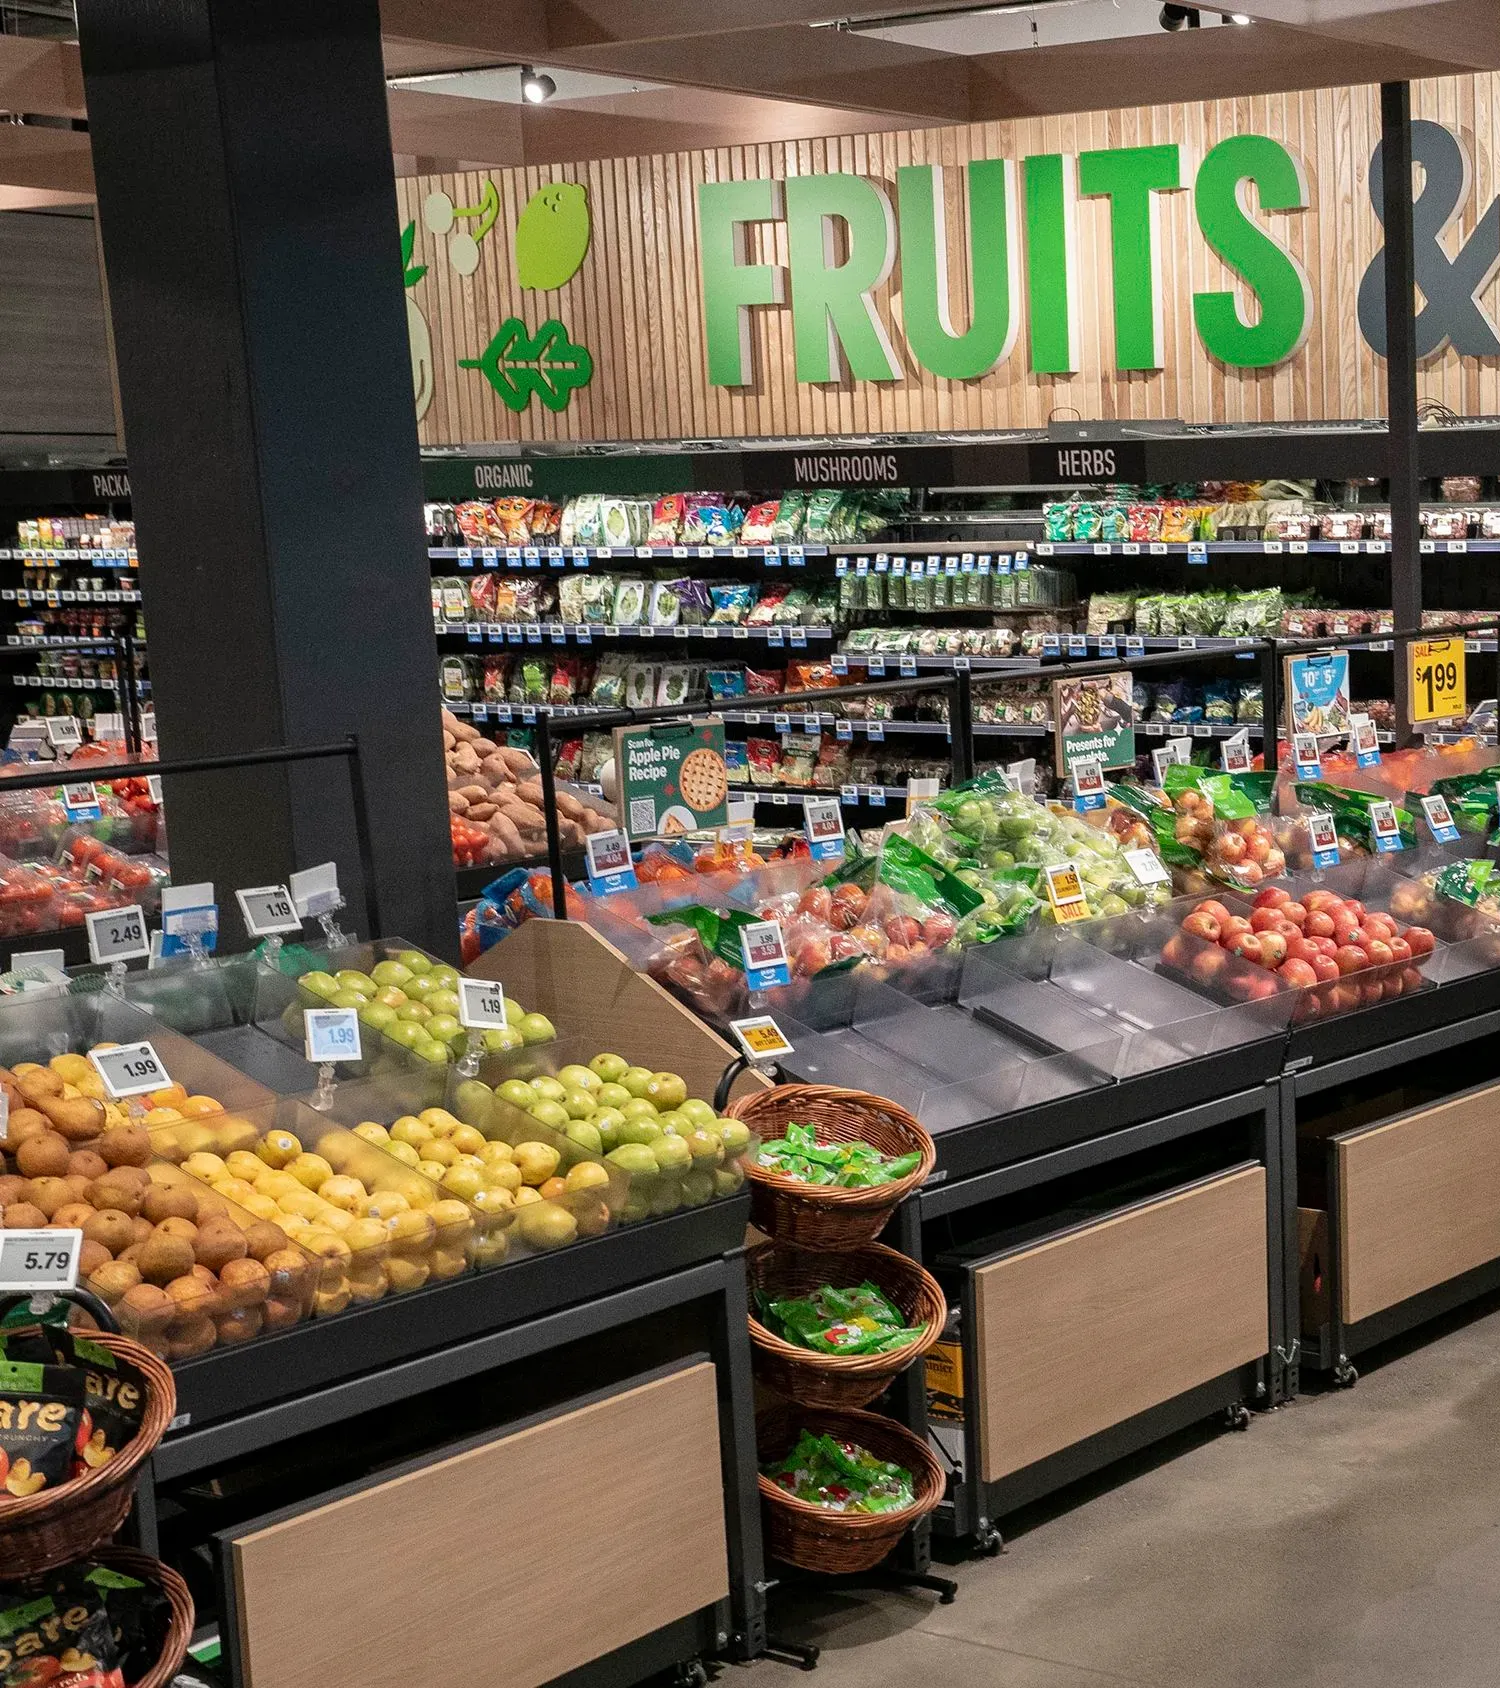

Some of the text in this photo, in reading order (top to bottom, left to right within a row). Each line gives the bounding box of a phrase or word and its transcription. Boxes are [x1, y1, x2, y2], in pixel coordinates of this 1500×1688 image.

[698, 133, 1313, 387] FRUITS
[795, 456, 898, 482] MUSHROOMS
[1058, 449, 1116, 476] HERBS
[474, 464, 532, 488] ORGANIC
[93, 475, 132, 496] PACKA
[1415, 645, 1433, 658] SALE
[1066, 736, 1116, 753] Presents for
[629, 745, 680, 766] Apple Pie
[629, 765, 667, 781] Recipe
[266, 901, 291, 917] 1.19
[1061, 903, 1084, 920] SALE
[111, 925, 141, 943] 2.49
[481, 998, 501, 1014] 1.19
[328, 1028, 355, 1044] 1.99
[760, 1027, 778, 1039] 5.49
[124, 1060, 158, 1077] 1.99
[25, 1252, 70, 1270] 5.79
[85, 1371, 140, 1410] are
[0, 1400, 67, 1431] are
